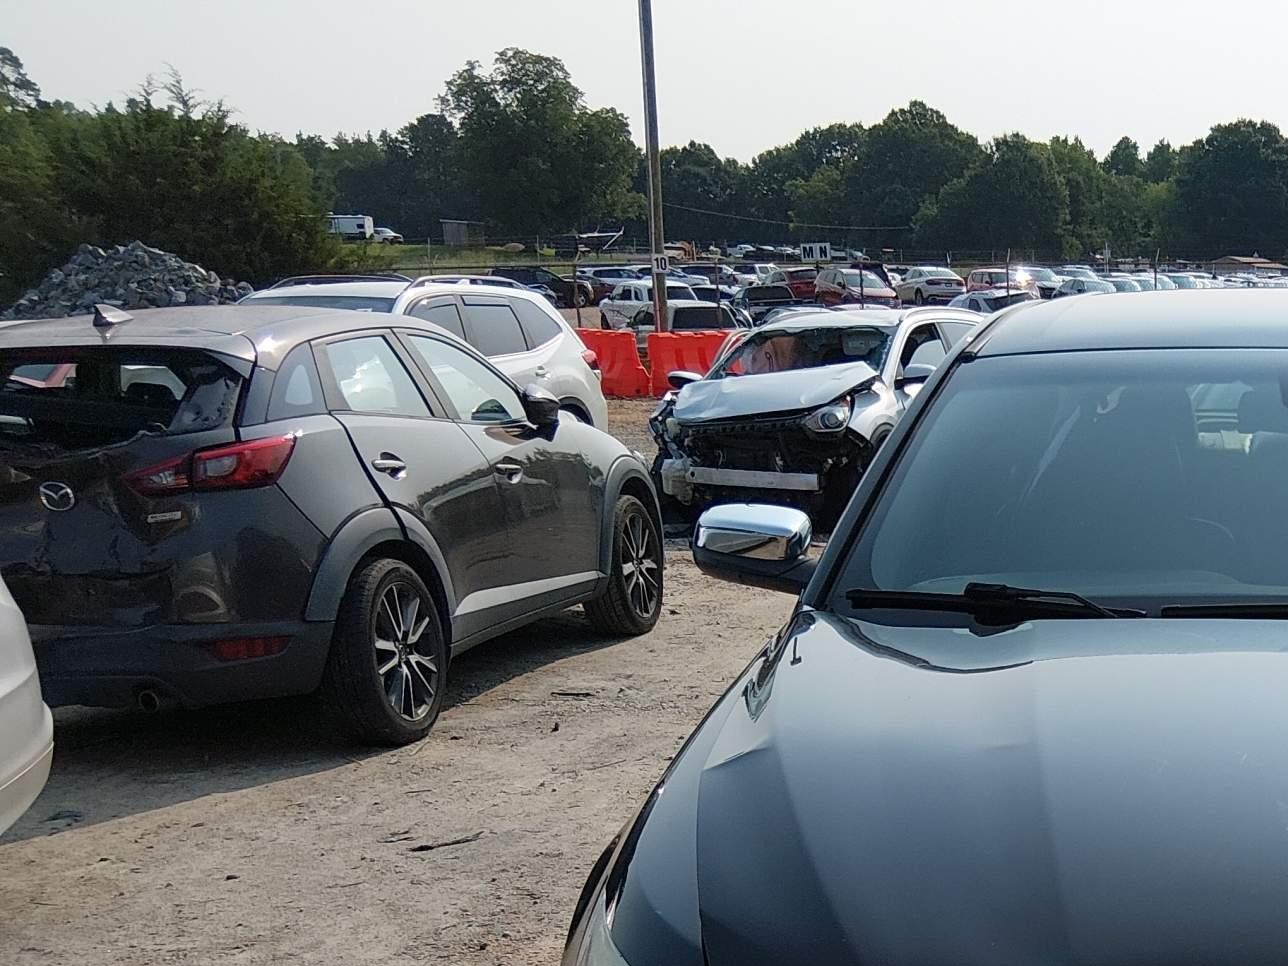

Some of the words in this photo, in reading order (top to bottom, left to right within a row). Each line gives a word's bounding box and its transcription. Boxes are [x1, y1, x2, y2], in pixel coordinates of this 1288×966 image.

[802, 246, 814, 259] M
[819, 245, 828, 259] N
[653, 256, 667, 271] 10
